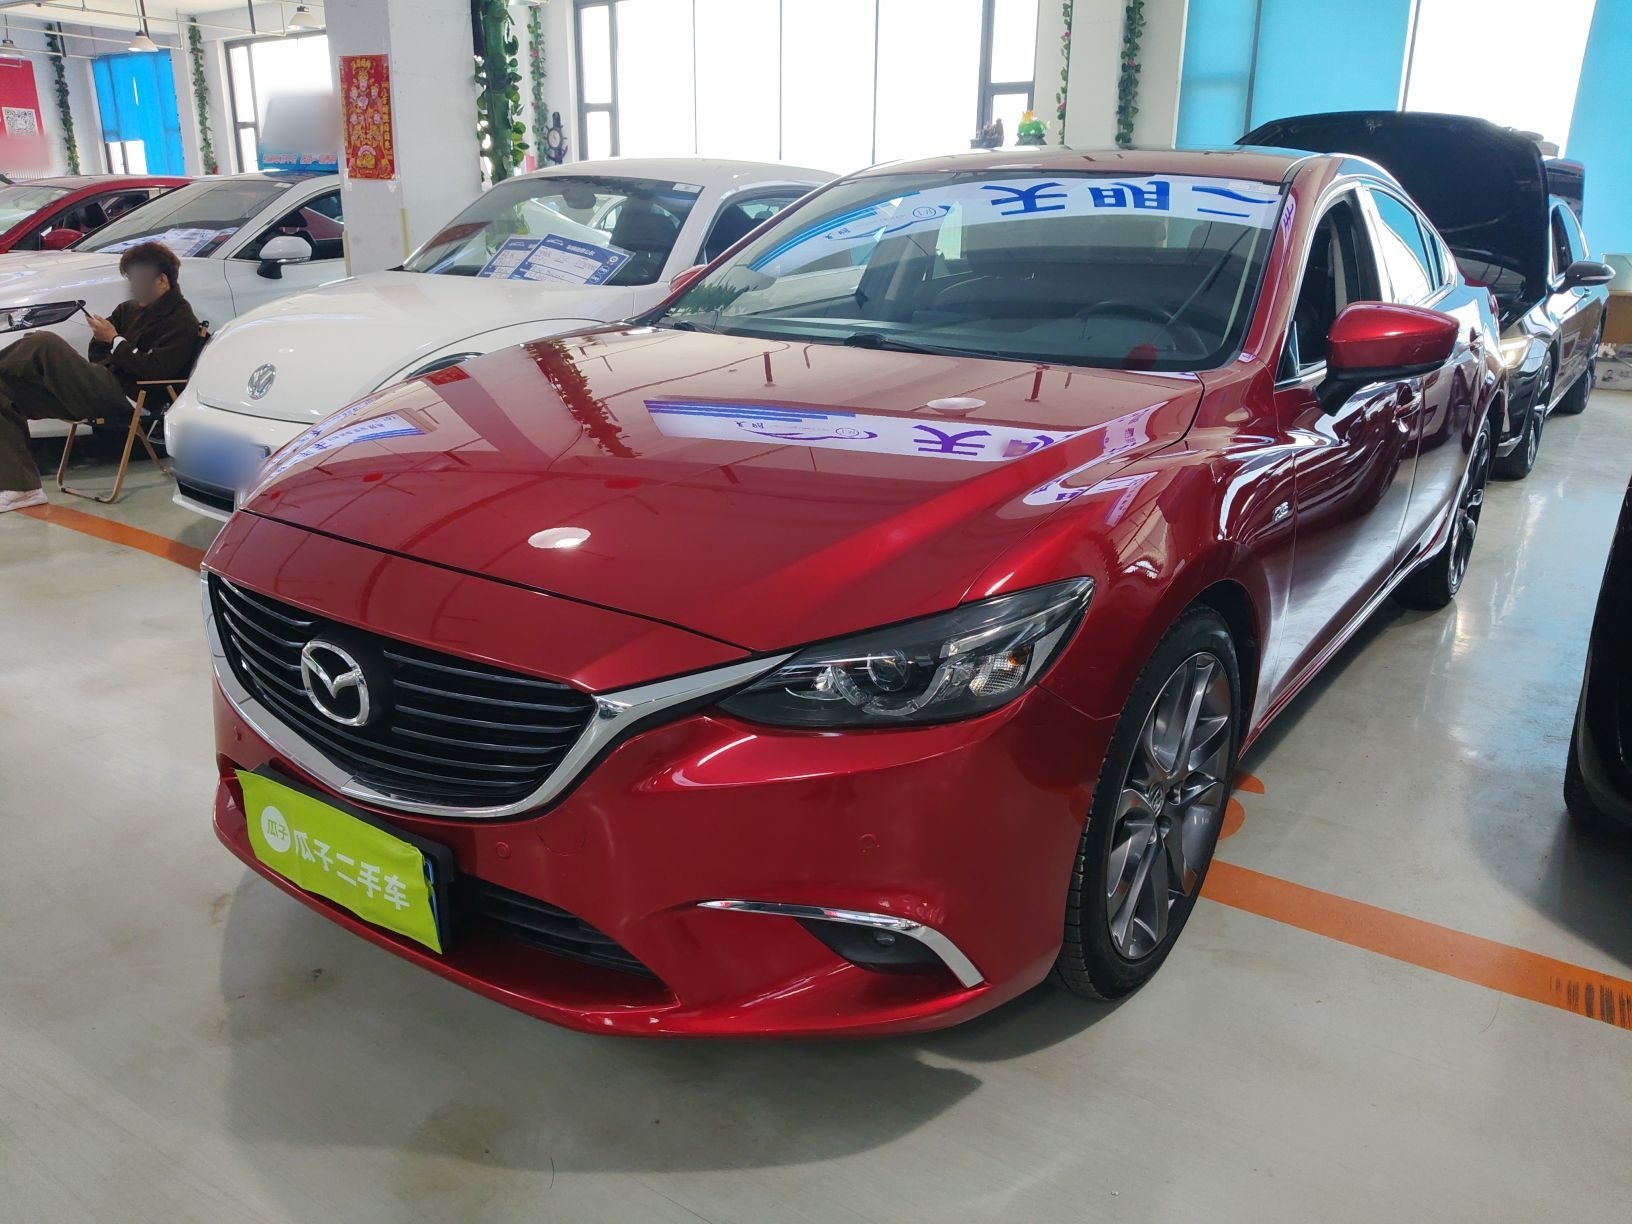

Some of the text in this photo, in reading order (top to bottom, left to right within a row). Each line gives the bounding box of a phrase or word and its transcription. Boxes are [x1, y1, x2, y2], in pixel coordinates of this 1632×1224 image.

[266, 819, 289, 841] 瓜子
[293, 829, 410, 911] 瓜子二手车
